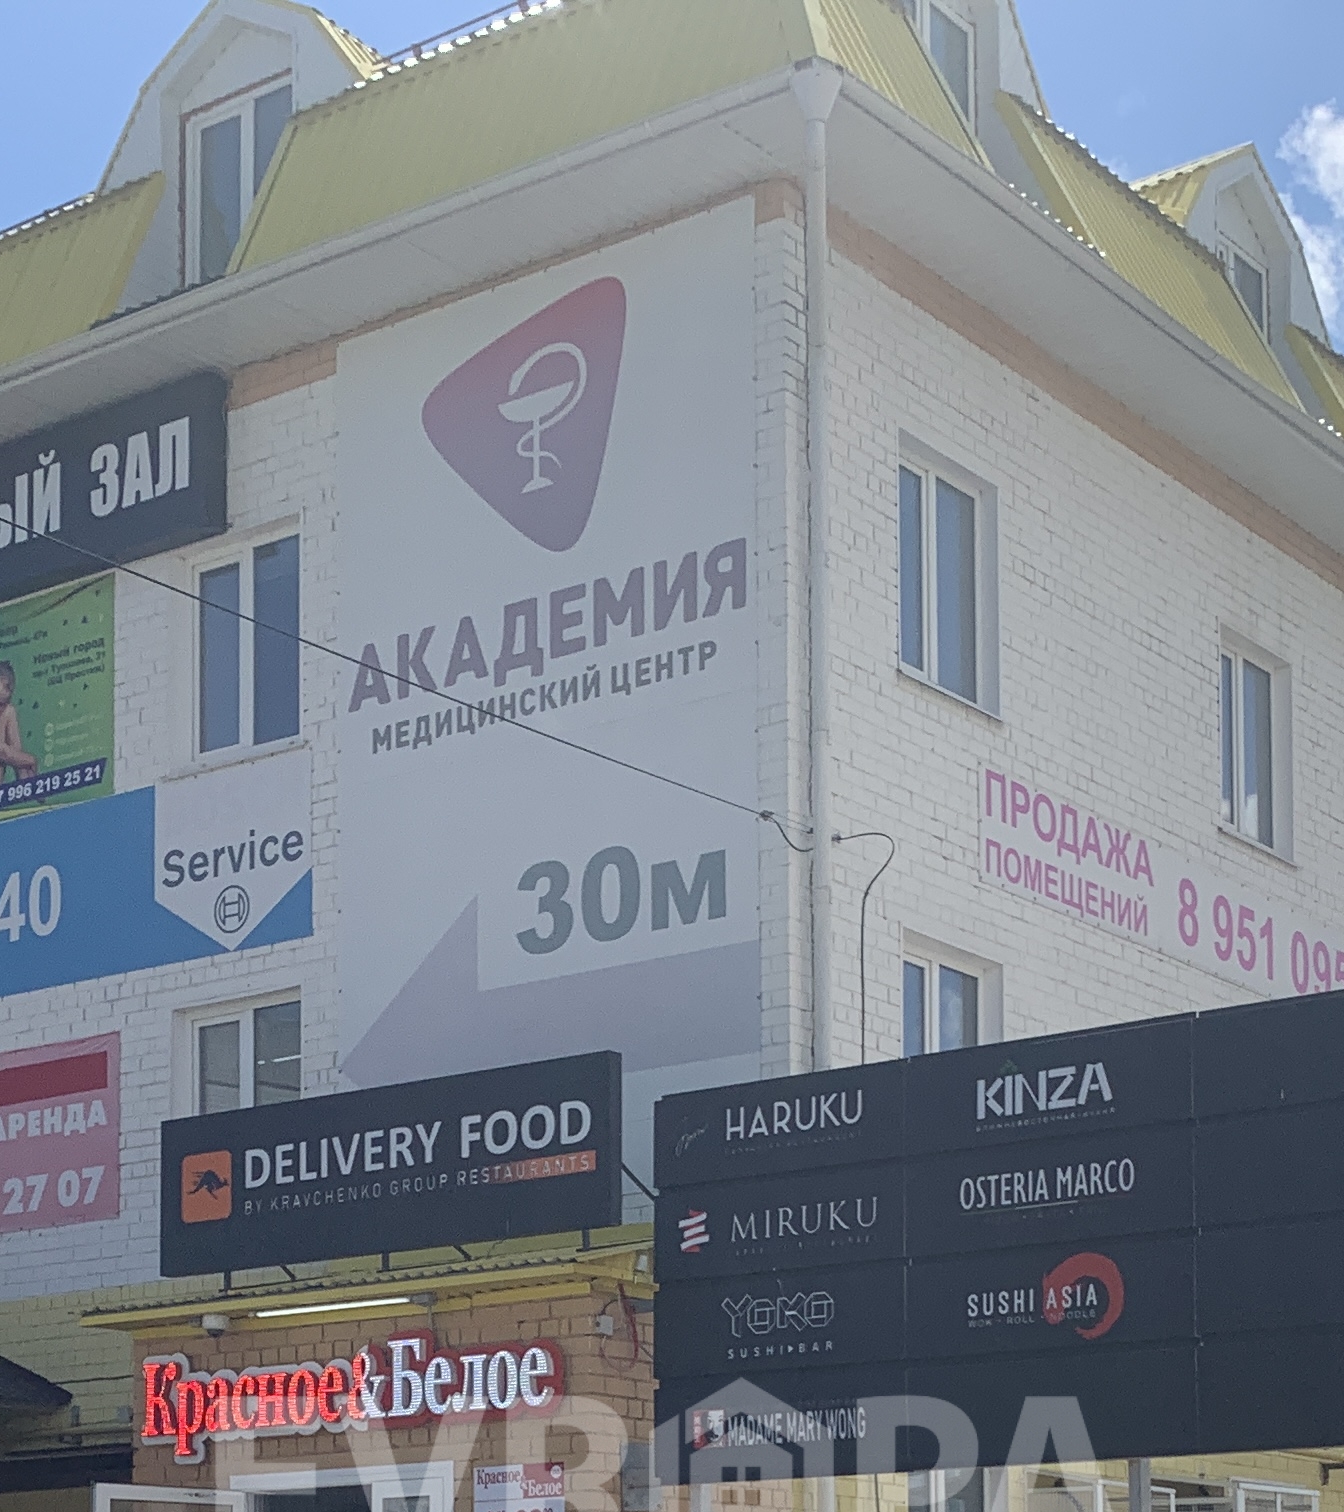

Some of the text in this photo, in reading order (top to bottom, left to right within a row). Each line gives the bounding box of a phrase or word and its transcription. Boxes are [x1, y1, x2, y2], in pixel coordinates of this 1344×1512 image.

[89, 416, 192, 518] ЗАЛ
[348, 537, 748, 713] АКАДЕМИЯ
[371, 639, 718, 755] МЕДИЦИНСКИЙ ЦЕНТР
[7, 782, 32, 801] 996
[35, 775, 61, 794] 219
[63, 770, 81, 787] 25
[84, 764, 100, 781] 21
[985, 769, 1155, 887] ПРОДАЖА
[162, 829, 305, 888] Service
[985, 838, 1149, 937] ПОМЕЩЕНИЙ
[1177, 878, 1199, 947] 8
[1212, 894, 1274, 981] 951
[726, 1089, 863, 1141] HARUKU
[976, 1062, 1113, 1120] KINZA
[245, 1100, 592, 1189] DELIVERY FOOD
[3, 1173, 49, 1216] 27
[57, 1165, 106, 1208] 07
[244, 1153, 590, 1216] BY KRAVCHENKO GROUP RESTAURANTS
[960, 1157, 1135, 1210] OSTERIA MARCO
[731, 1196, 878, 1243] MIRUKU
[721, 1291, 834, 1338] YOKO
[967, 1283, 1098, 1318] SUSHI ASIA
[1006, 1315, 1035, 1325] ROLL
[727, 1340, 833, 1360] SUSHI BAR
[139, 1337, 555, 1456] Красное&Белое
[727, 1412, 784, 1447] MADAME
[786, 1409, 823, 1443] MARY
[825, 1406, 866, 1440] WONG
[476, 1469, 521, 1489] Красное
